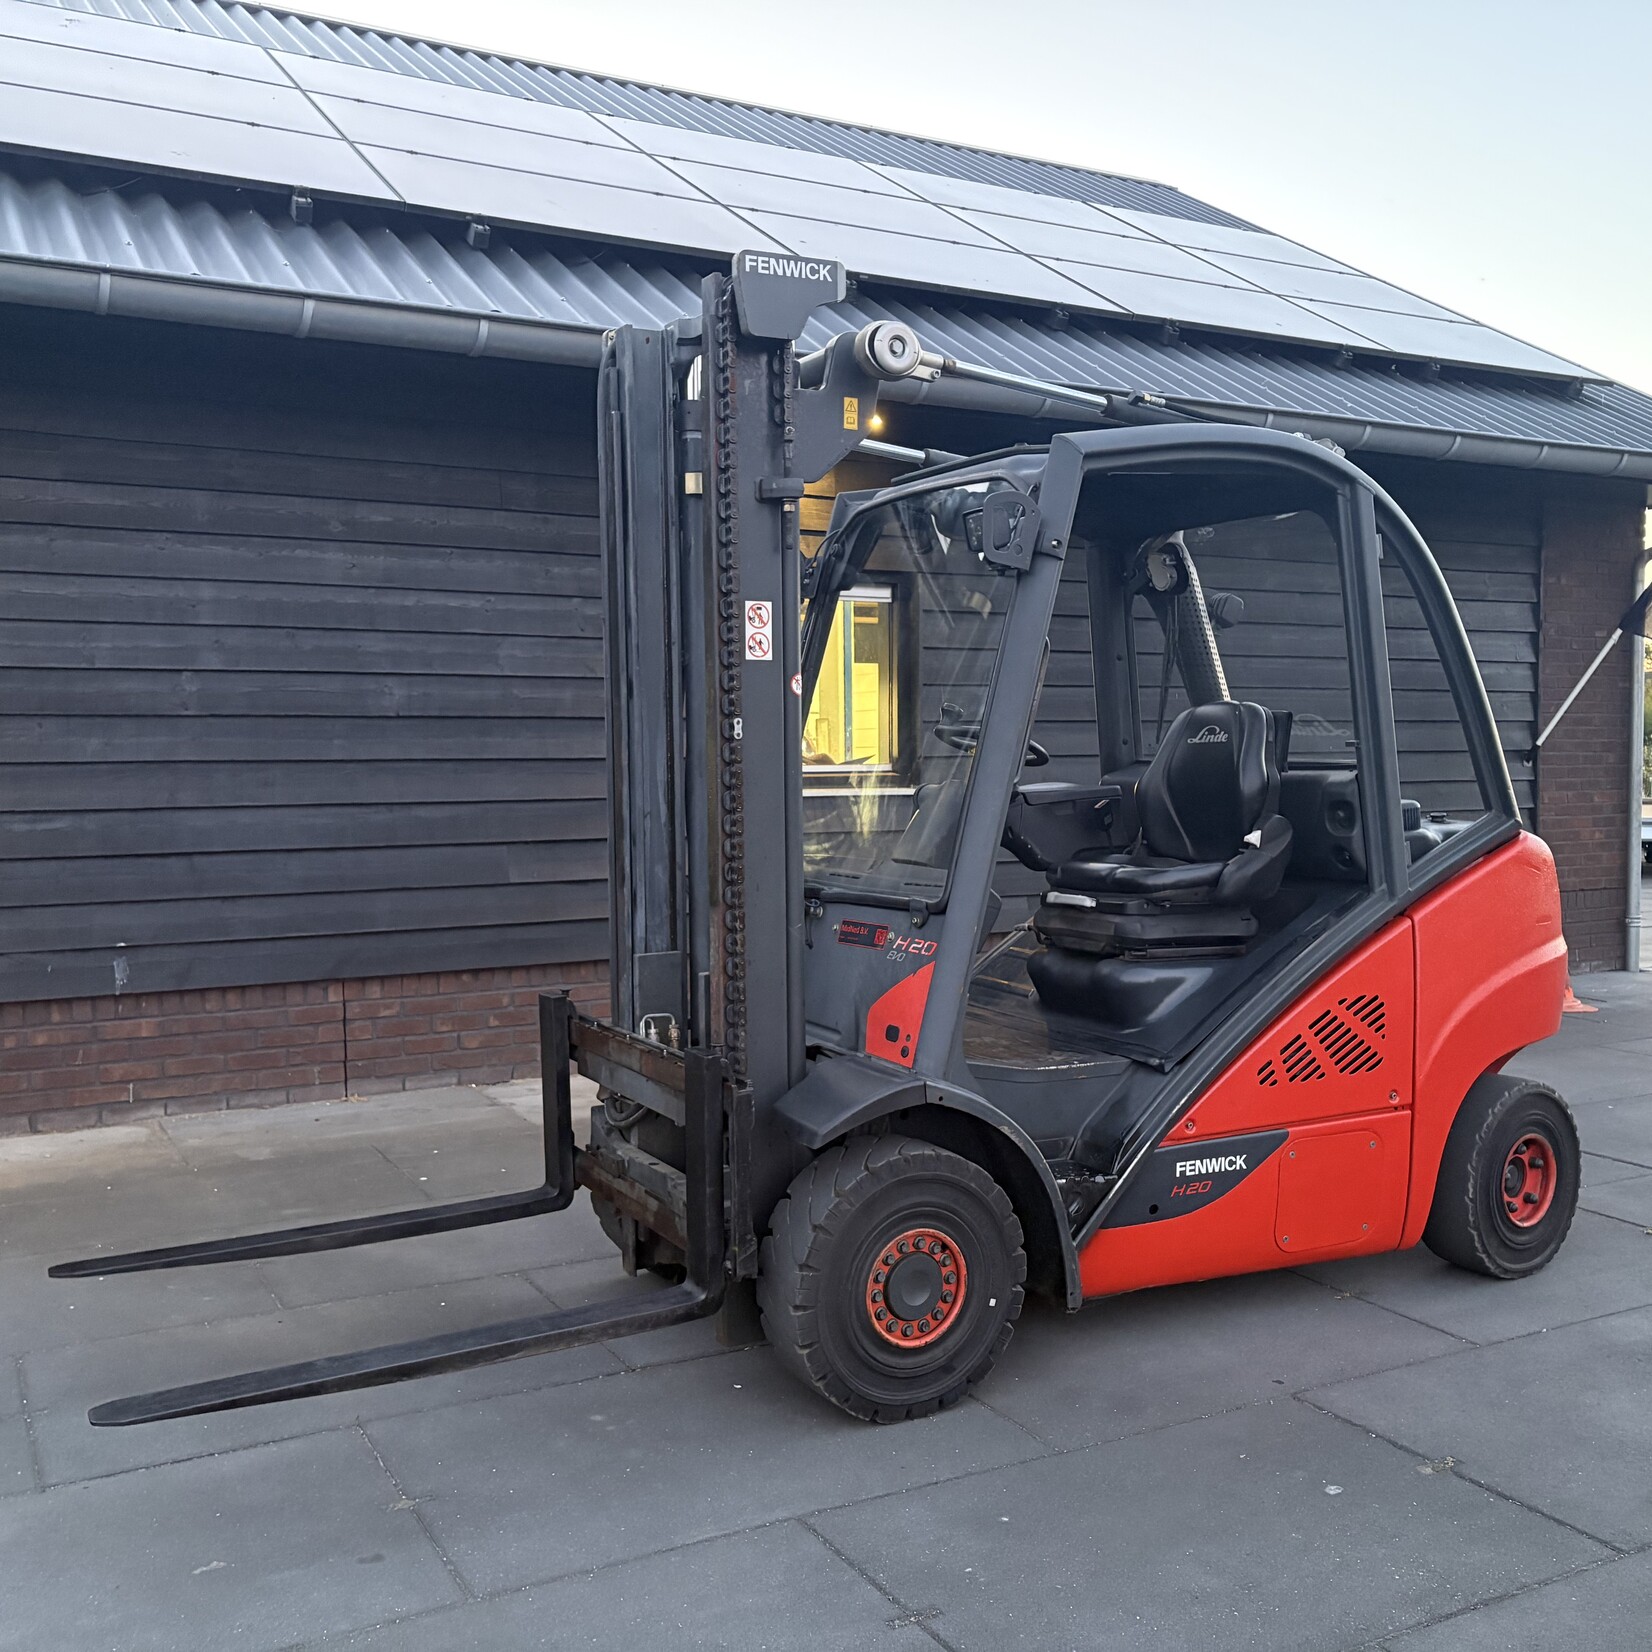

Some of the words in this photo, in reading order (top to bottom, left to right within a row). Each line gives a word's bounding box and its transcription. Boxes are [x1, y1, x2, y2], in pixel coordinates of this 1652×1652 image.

[745, 254, 832, 282] FENWICK
[1187, 725, 1229, 743] Linde
[887, 951, 906, 962] EVO
[1176, 1154, 1247, 1177] FENWICK
